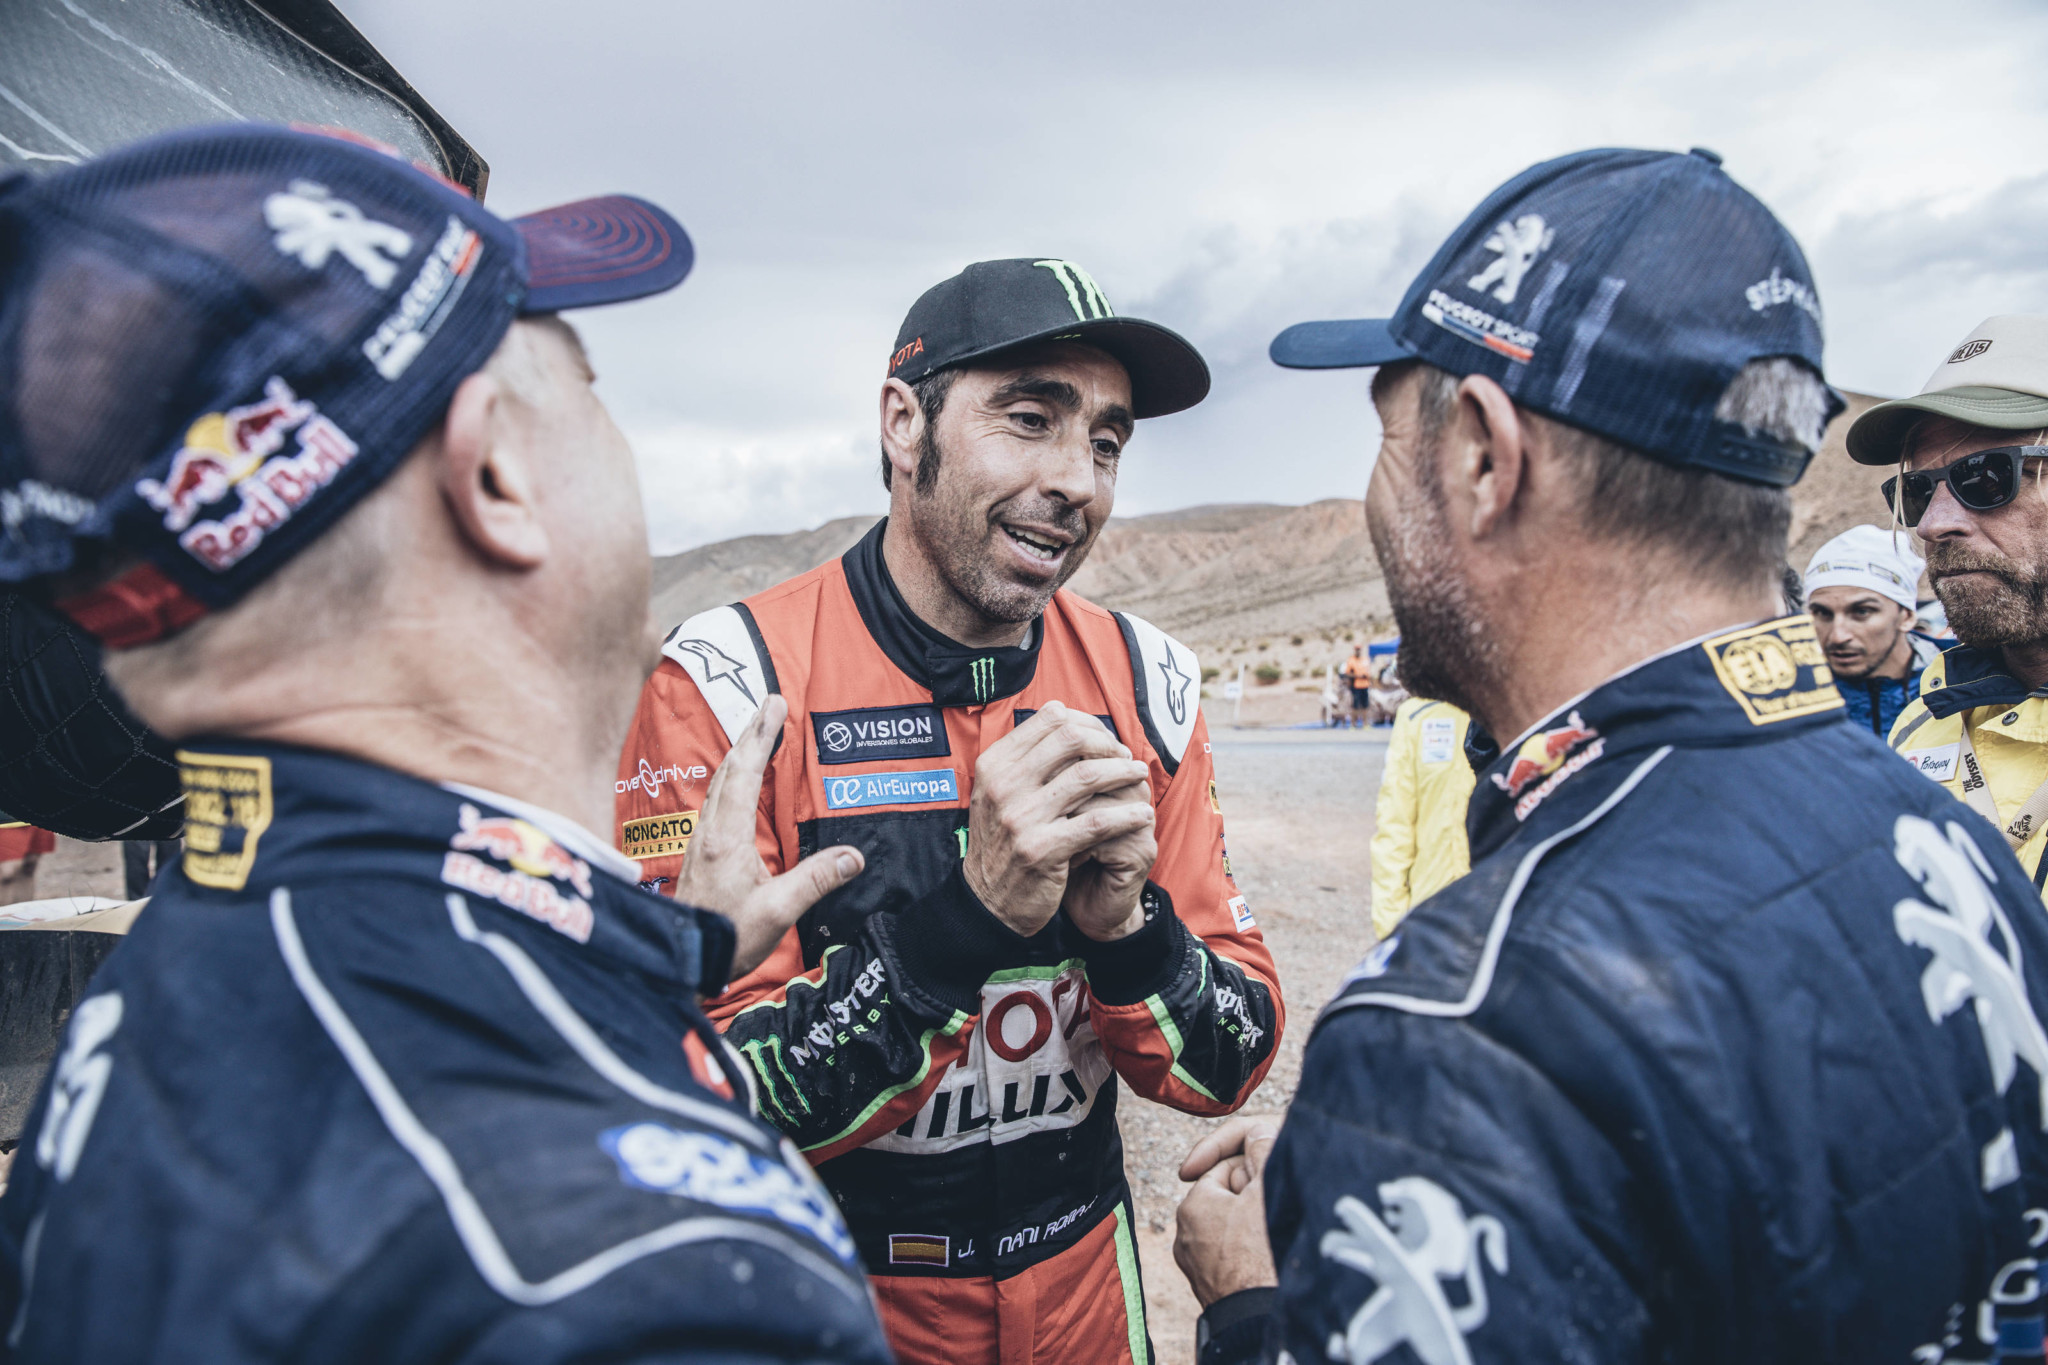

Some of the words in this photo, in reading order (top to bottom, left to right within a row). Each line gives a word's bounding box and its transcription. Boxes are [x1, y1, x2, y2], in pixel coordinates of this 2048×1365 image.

[1428, 289, 1495, 331] PEUGEOT
[1493, 318, 1540, 351] SPORT
[1951, 342, 1987, 361] DEUS
[180, 477, 291, 573] Red
[258, 412, 359, 512] Bull
[853, 716, 932, 740] VISION
[856, 738, 898, 748] INVERSIONES
[899, 736, 934, 746] GLOBALES
[1920, 756, 1951, 774] Paraguay
[1963, 752, 1984, 789] ODYSSEY
[867, 779, 950, 798] AirEuropa
[1962, 778, 1975, 793] THE
[624, 818, 693, 843] RONCATO
[440, 850, 527, 913] Red
[523, 873, 595, 945] Bull
[825, 992, 892, 1067] EERGY
[957, 1238, 975, 1259] J.
[997, 1225, 1041, 1257] NANI
